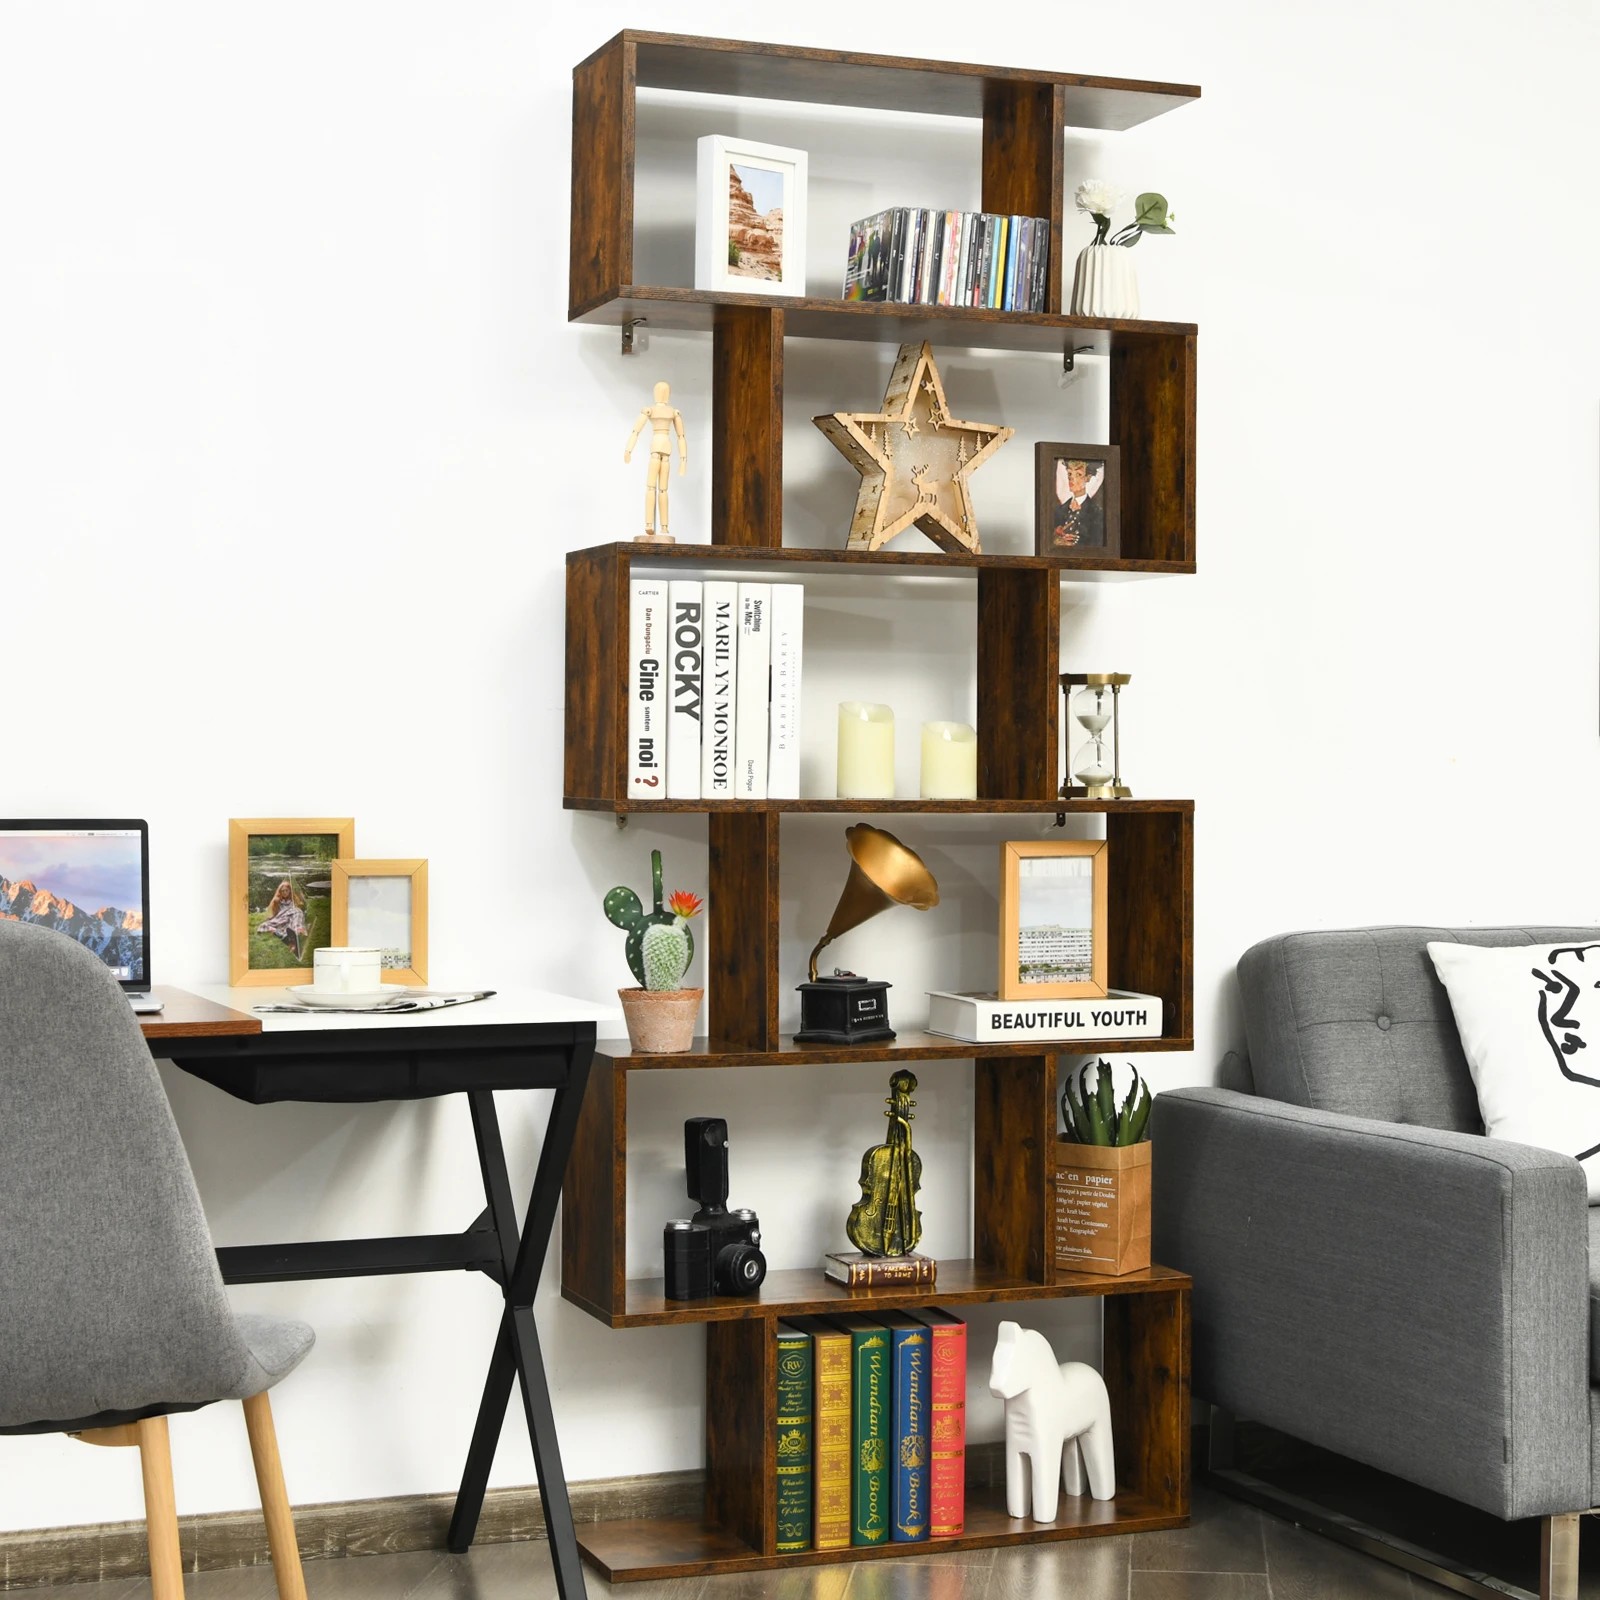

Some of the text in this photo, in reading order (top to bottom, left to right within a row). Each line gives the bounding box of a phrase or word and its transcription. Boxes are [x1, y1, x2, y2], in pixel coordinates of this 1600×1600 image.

[644, 607, 653, 655] Dan Dungaciu
[744, 611, 753, 626] Mac
[752, 599, 763, 633] Switching
[674, 602, 702, 722] ROCKY
[639, 658, 659, 702] Cine
[712, 601, 730, 790] MARILYN MONROE
[638, 738, 658, 768] noi
[634, 775, 659, 788] ?
[746, 759, 755, 792] David Pogue
[991, 1010, 1148, 1030] BEAUTIFUL YOUTH
[1056, 1172, 1113, 1187] ac en papier
[1080, 1189, 1093, 1197] partir
[1099, 1190, 1116, 1199] Double
[1076, 1199, 1091, 1208] papier
[866, 1351, 883, 1529] Wandian Book
[906, 1348, 923, 1526] Wandian Book
